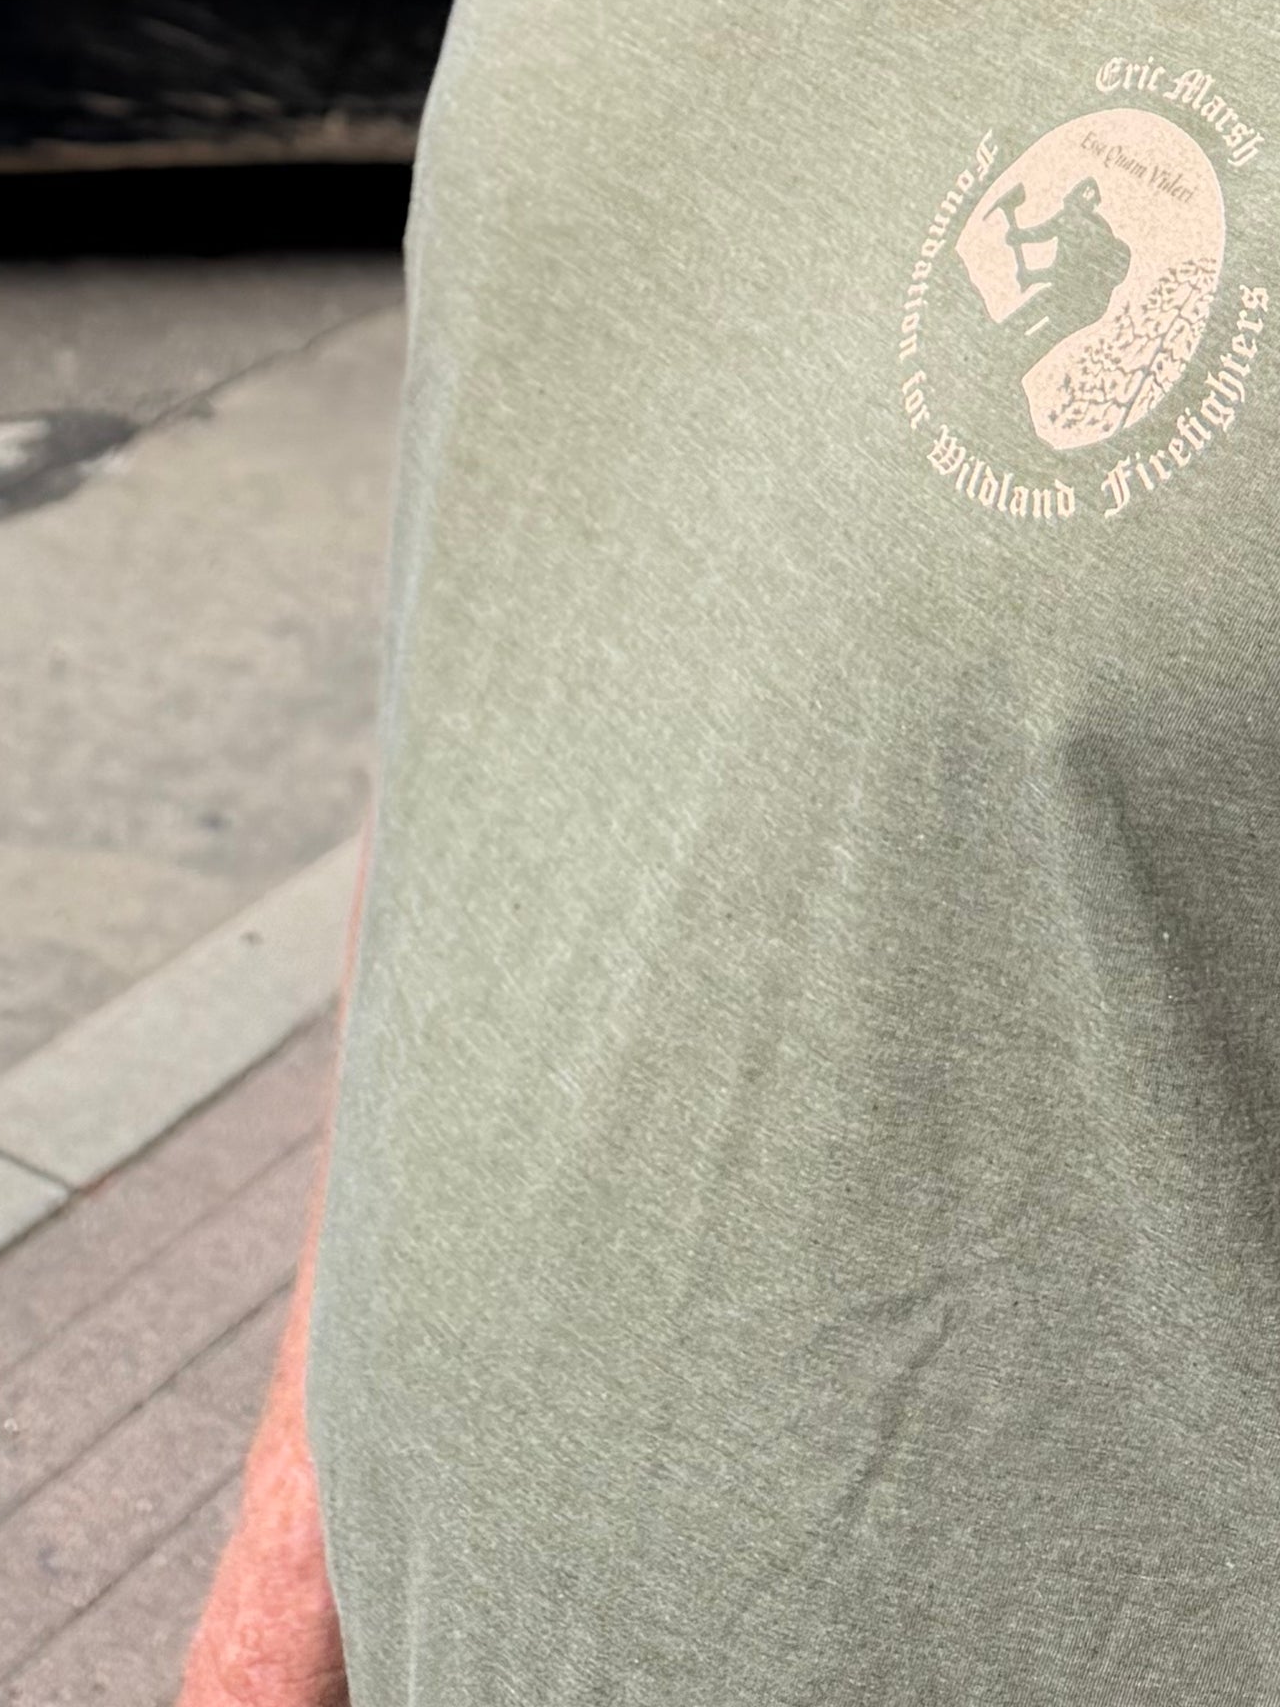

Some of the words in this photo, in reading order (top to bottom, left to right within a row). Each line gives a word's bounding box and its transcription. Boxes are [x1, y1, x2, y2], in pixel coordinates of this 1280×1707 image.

[1095, 56, 1167, 93] Eric
[1162, 68, 1265, 167] Marsh
[1103, 145, 1148, 179] Quam
[1148, 164, 1199, 204] Videri
[899, 128, 998, 362] Foundation
[902, 370, 930, 430] for
[1101, 284, 1270, 519] Firefighters
[927, 424, 1076, 519] Wildland
